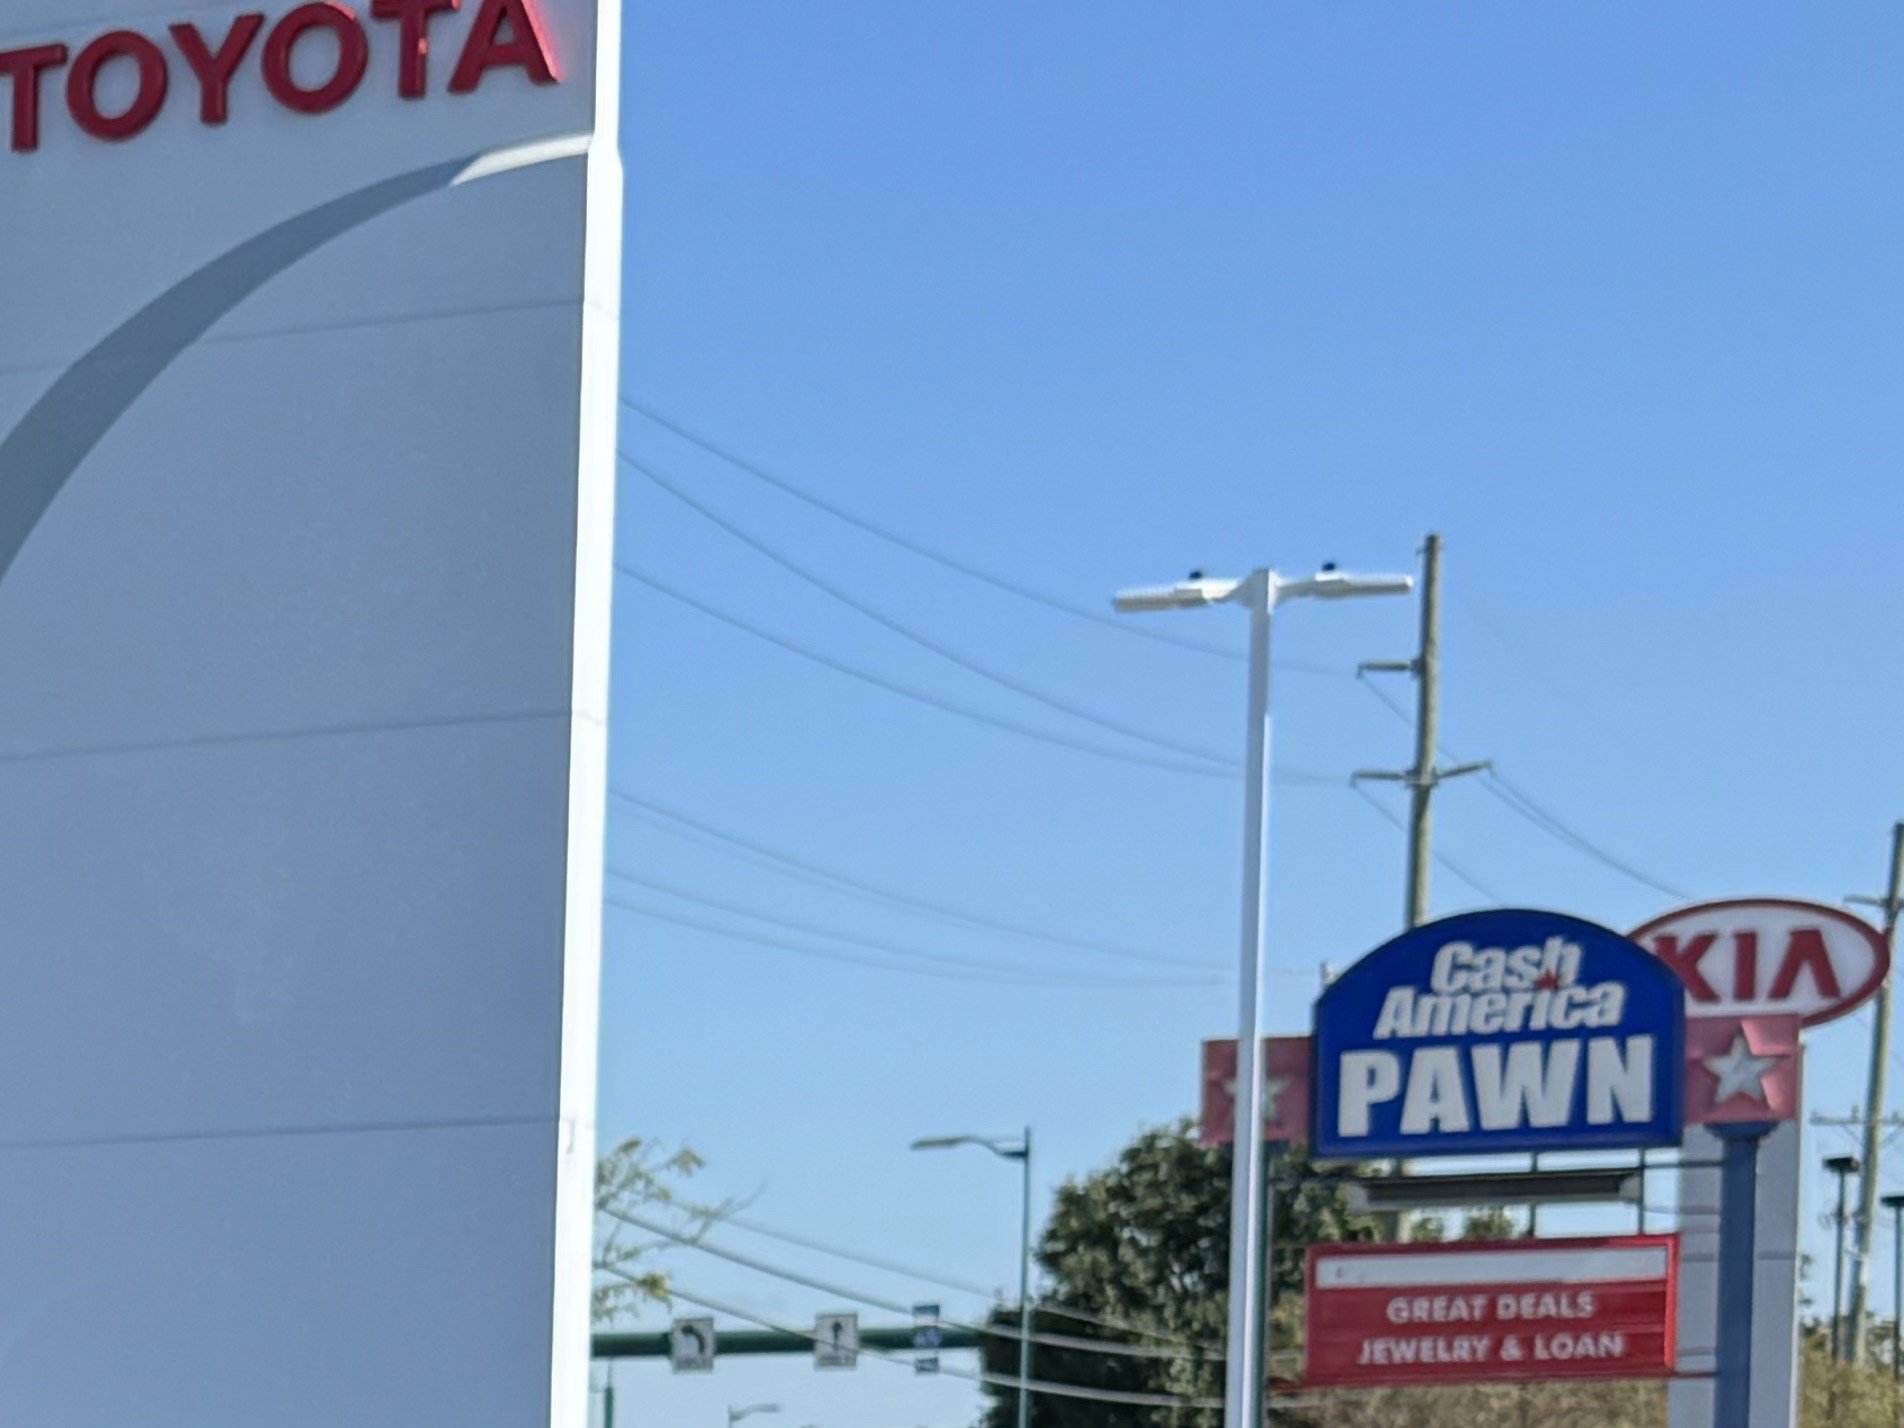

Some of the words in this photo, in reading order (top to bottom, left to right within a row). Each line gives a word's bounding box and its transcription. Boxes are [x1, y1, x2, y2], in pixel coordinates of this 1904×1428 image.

[1430, 935, 1582, 994] Cash
[1654, 929, 1842, 1004] KIA
[1372, 981, 1625, 1040] America
[1337, 1034, 1654, 1138] PAWN
[1386, 1294, 1489, 1324] GREAT
[1495, 1288, 1596, 1320] DEALS
[1356, 1336, 1492, 1365] JEWELRY
[1499, 1333, 1524, 1362] &
[1533, 1330, 1625, 1361] LOAN
